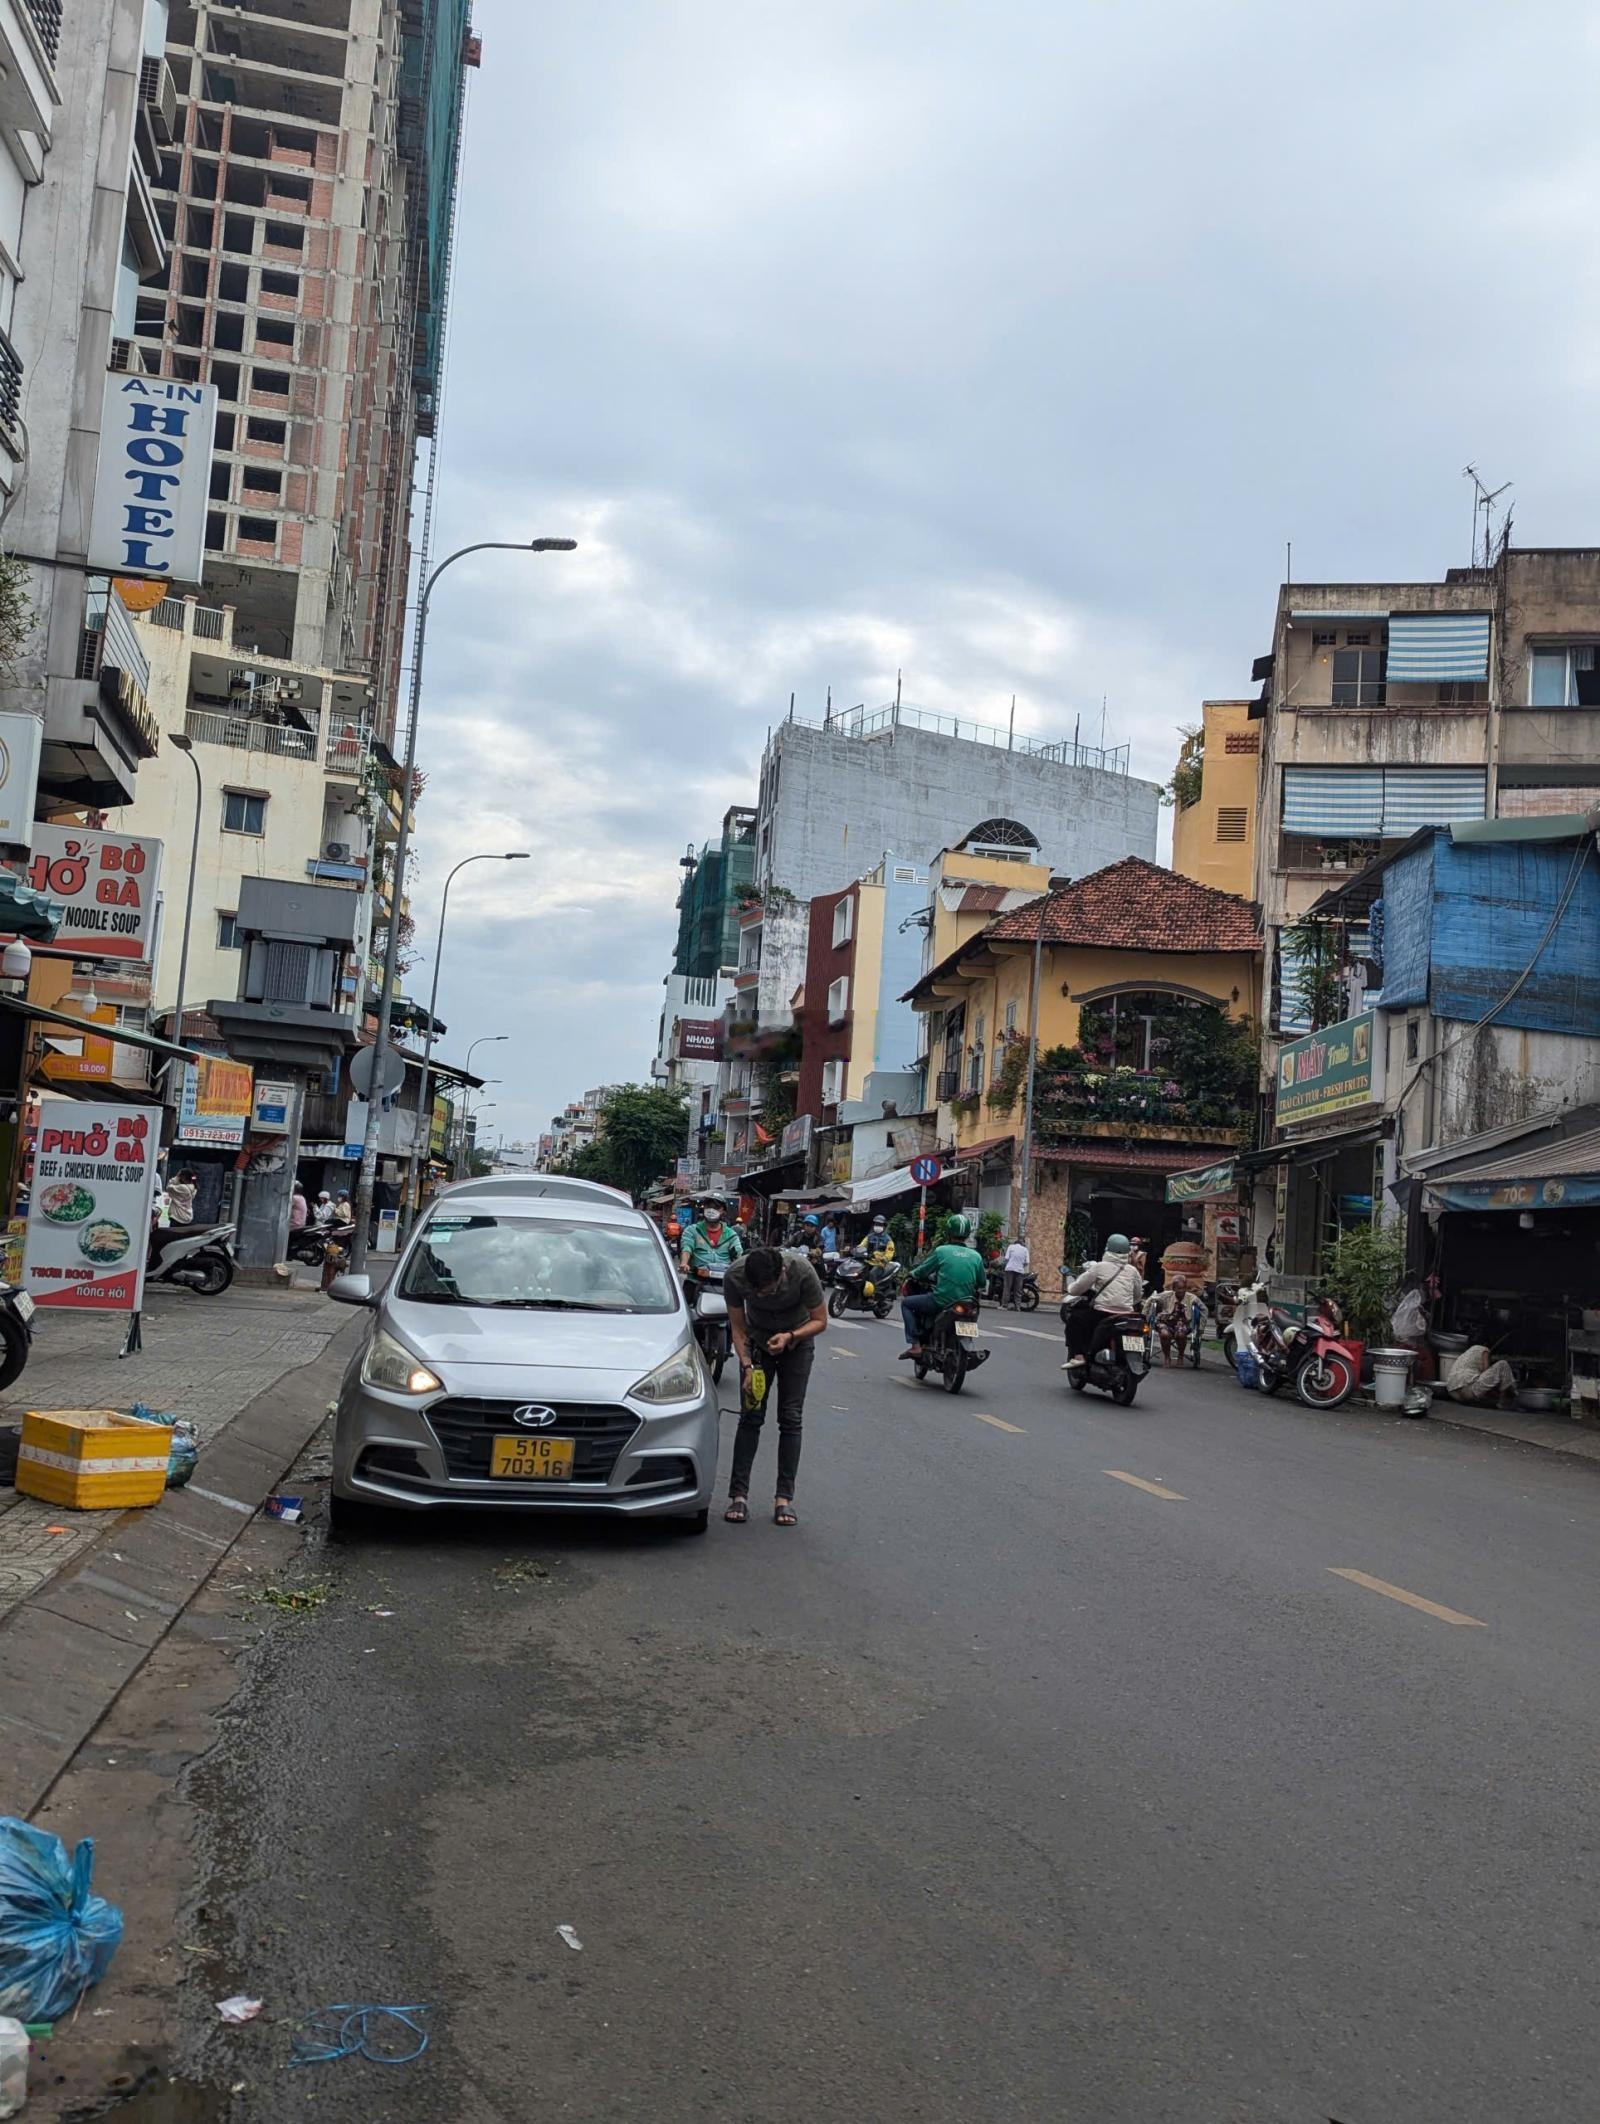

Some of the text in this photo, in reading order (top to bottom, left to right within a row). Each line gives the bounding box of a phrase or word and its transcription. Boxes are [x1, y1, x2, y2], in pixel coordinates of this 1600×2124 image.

[121, 378, 203, 404] A-IN
[120, 402, 190, 572] HOTEL
[28, 840, 90, 895] HỞ
[100, 842, 146, 874] BÒ
[96, 876, 141, 908] GÀ
[65, 906, 141, 935] NOODLE SOUP
[1323, 1081, 1344, 1099] FRESH
[1344, 1073, 1369, 1093] FRUITS
[117, 1114, 148, 1138] BÒ
[184, 1126, 241, 1141] 0913.723.097
[41, 1122, 110, 1157] PHỞ
[114, 1138, 145, 1163] GÀ
[39, 1159, 58, 1177] BEEF
[64, 1161, 94, 1180] CHICKEN
[96, 1163, 123, 1182] NOODLE
[124, 1165, 145, 1183] SOUP
[516, 1440, 551, 1457] 51G
[501, 1457, 563, 1477] 703.16
